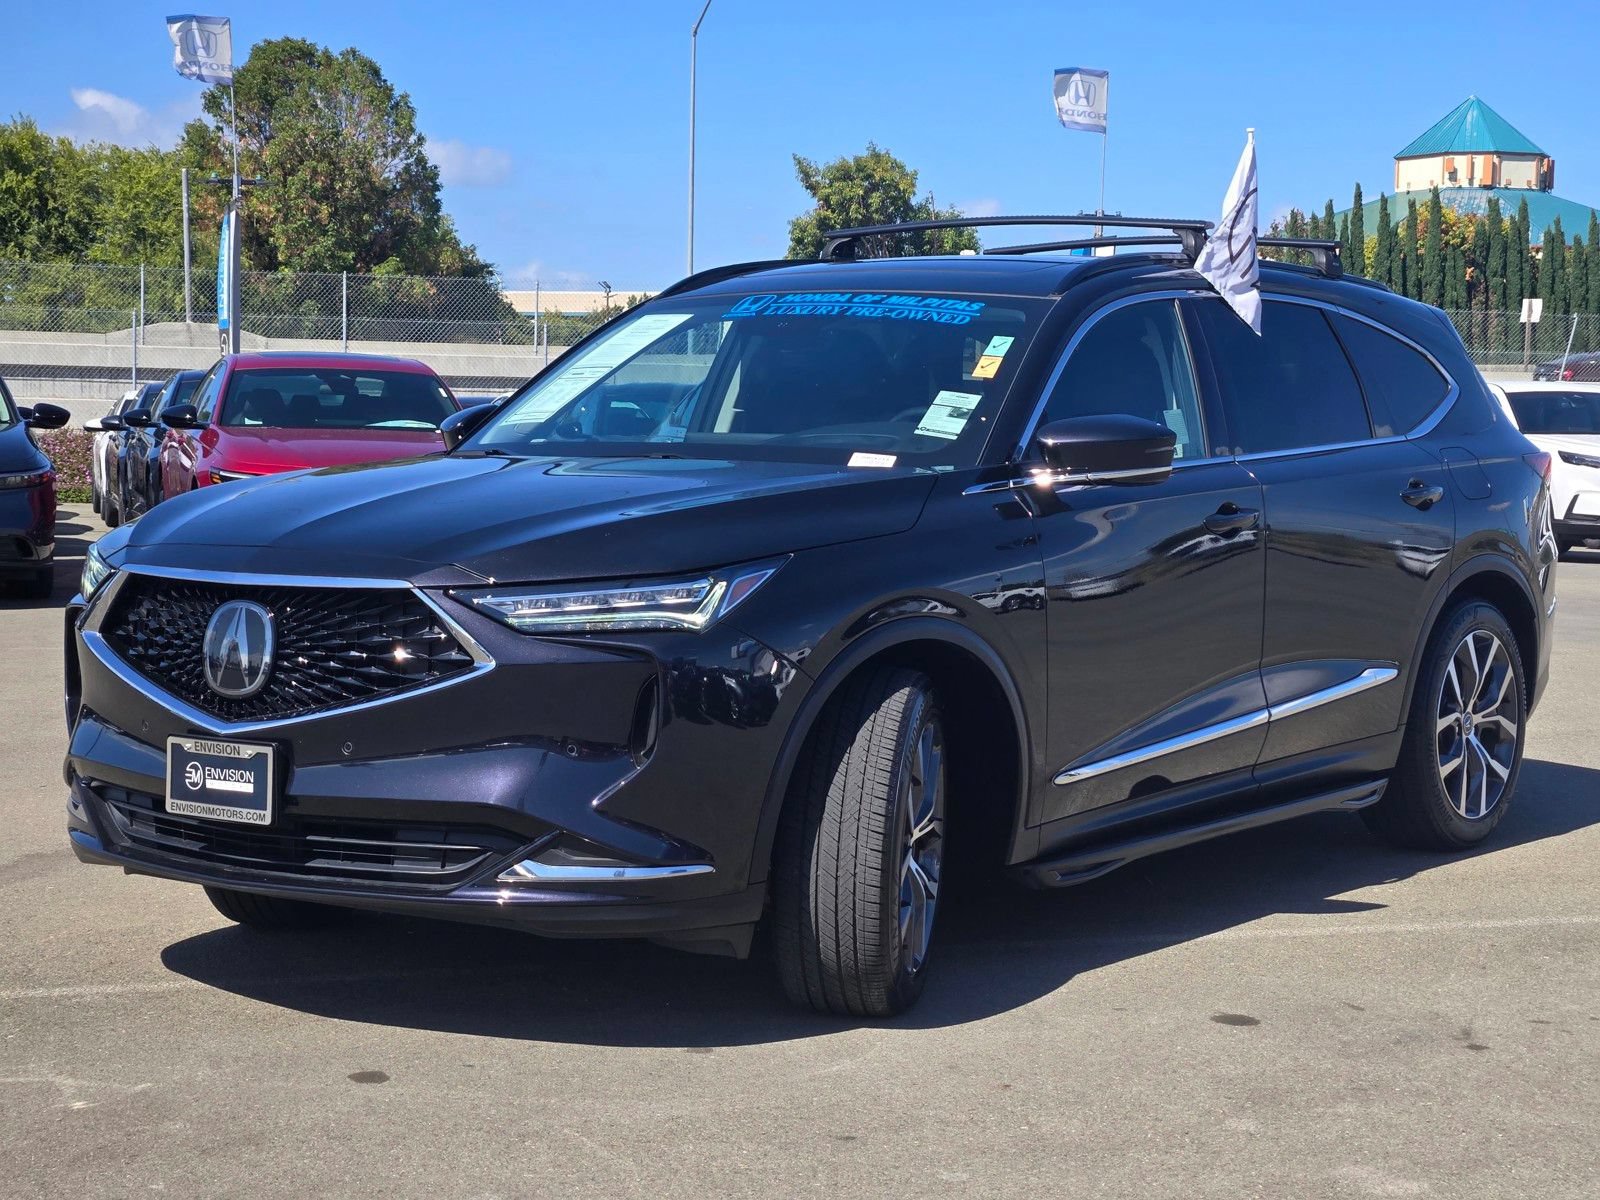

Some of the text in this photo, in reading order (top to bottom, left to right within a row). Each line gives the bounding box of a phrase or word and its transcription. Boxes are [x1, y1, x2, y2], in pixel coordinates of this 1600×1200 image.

[778, 294, 986, 311] HONDA OF MILPITAS
[762, 305, 971, 325] LUXURY PRE-OWNED
[194, 741, 241, 756] ENVISION
[205, 767, 254, 783] ENVISION
[170, 801, 266, 822] ENVISIONMOTORS.COM
